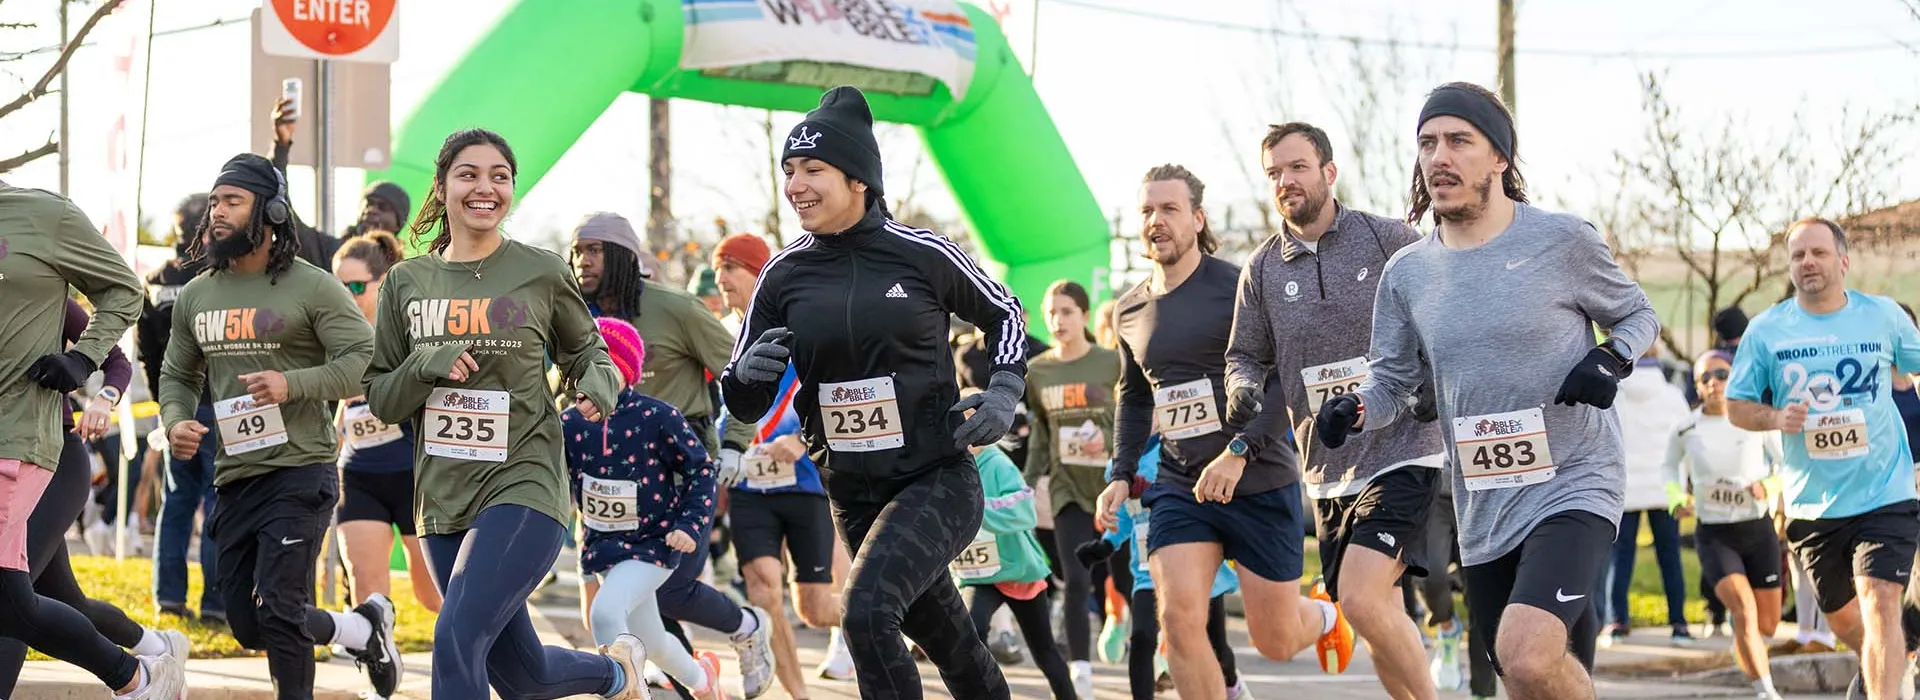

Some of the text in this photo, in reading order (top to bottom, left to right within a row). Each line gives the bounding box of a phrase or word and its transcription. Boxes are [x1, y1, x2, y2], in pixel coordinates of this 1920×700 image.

[293, 0, 370, 30] ENTER
[885, 290, 909, 299] adidas
[195, 308, 256, 343] GW5K
[408, 298, 491, 339] GW5K
[499, 340, 522, 349] 2025
[237, 415, 266, 436] 49
[831, 406, 889, 434] 234
[1167, 402, 1208, 427] 773
[437, 415, 495, 442] 235
[1814, 429, 1859, 449] 804
[1473, 440, 1536, 470] 483
[755, 460, 779, 476] 14
[587, 496, 626, 518] 529
